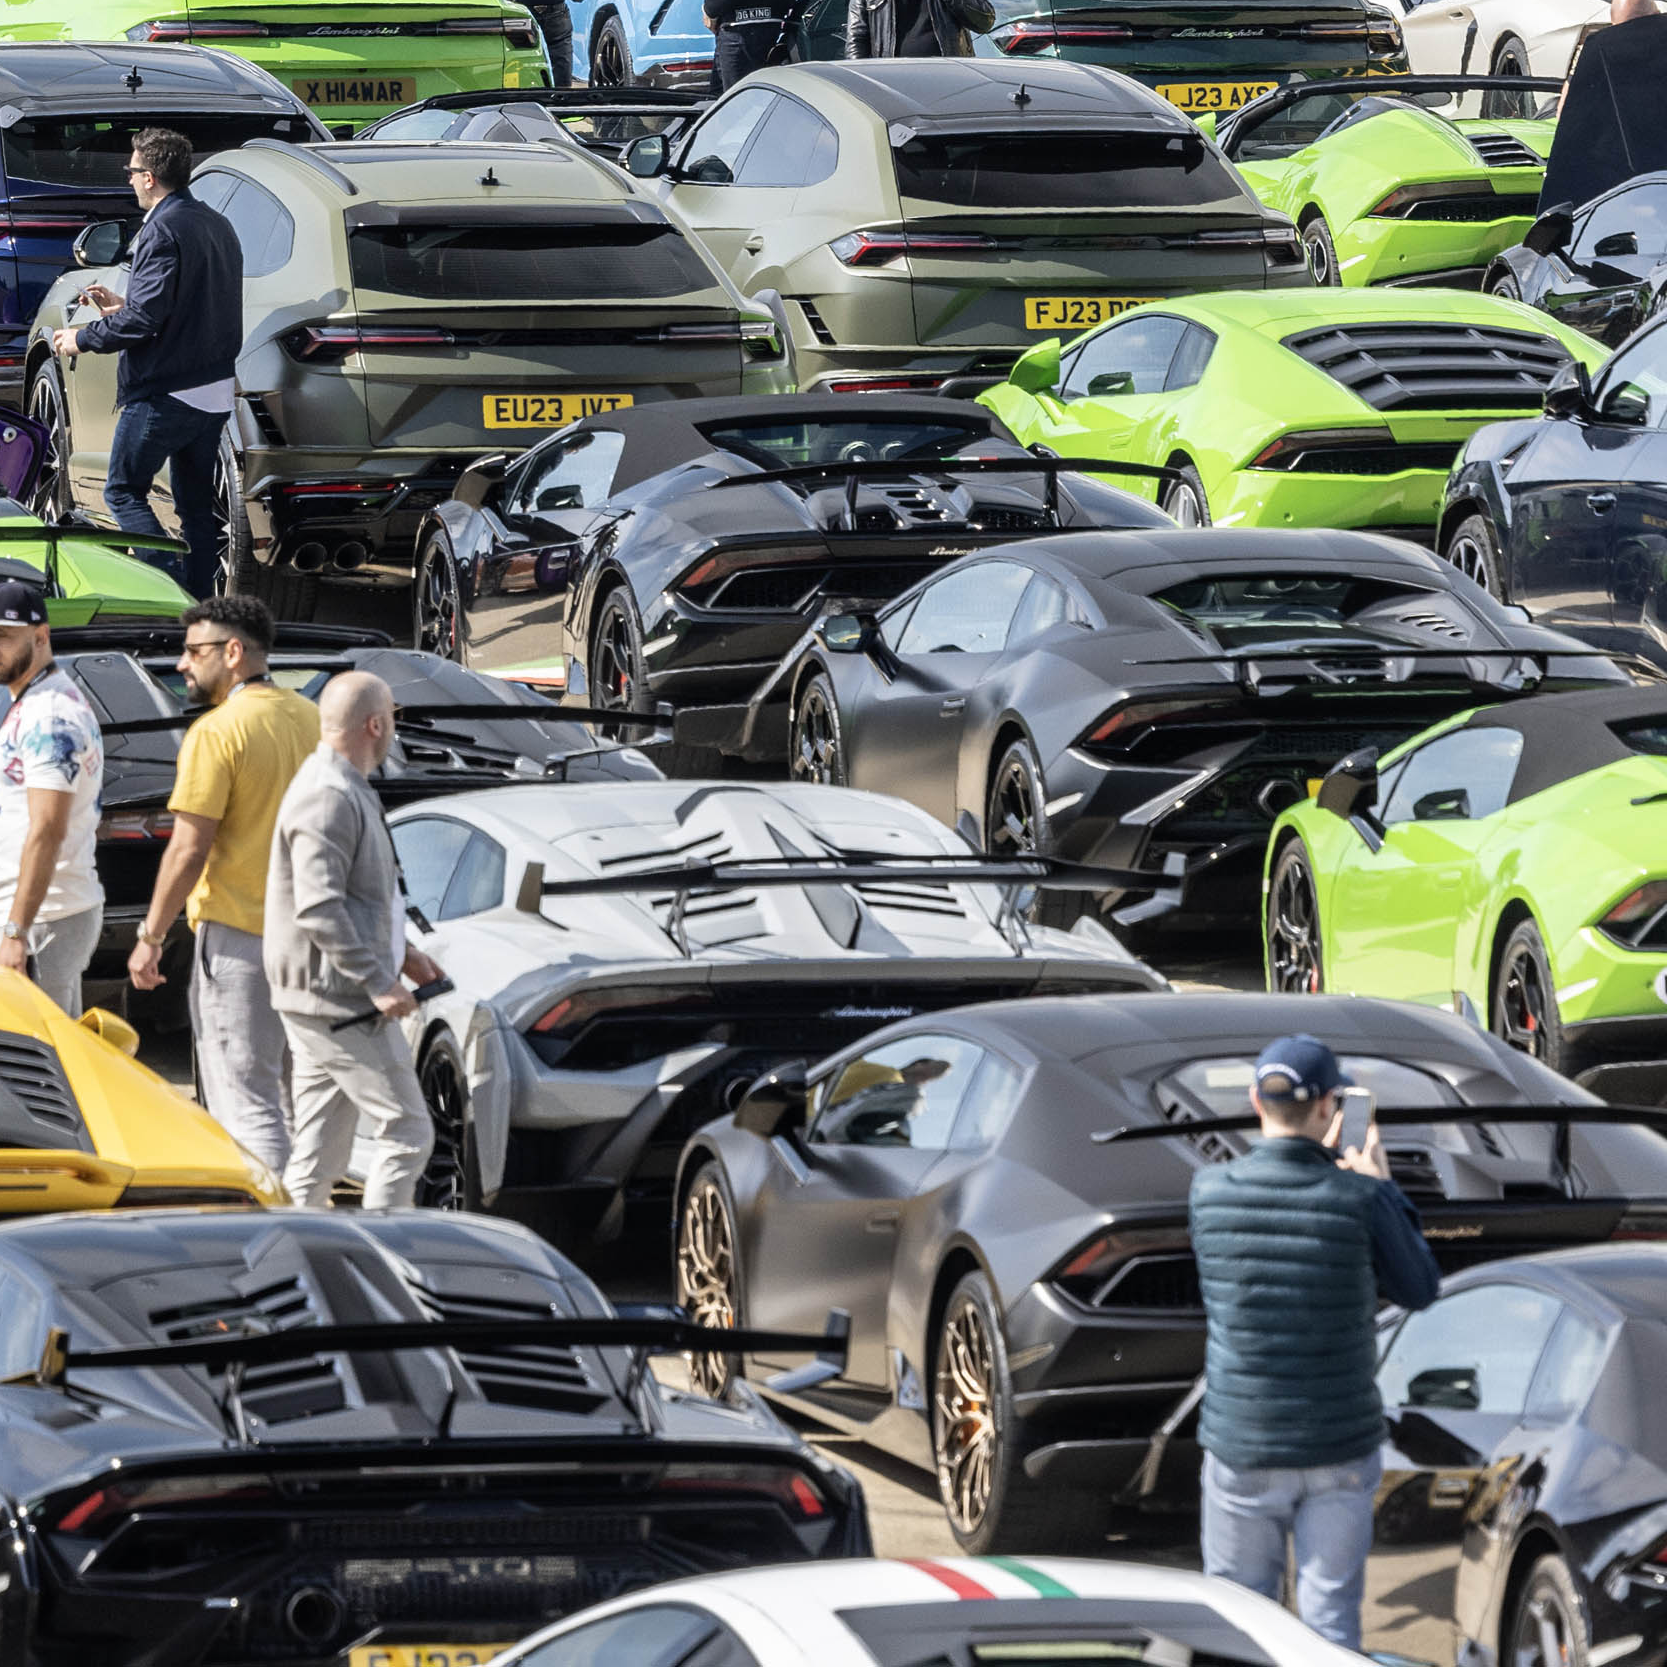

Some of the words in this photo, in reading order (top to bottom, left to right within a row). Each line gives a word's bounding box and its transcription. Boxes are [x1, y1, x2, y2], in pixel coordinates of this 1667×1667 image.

[749, 8, 771, 19] KING
[306, 26, 402, 38] Lamborghini
[1035, 301, 1101, 324] FJ23
[495, 398, 564, 423] EU23
